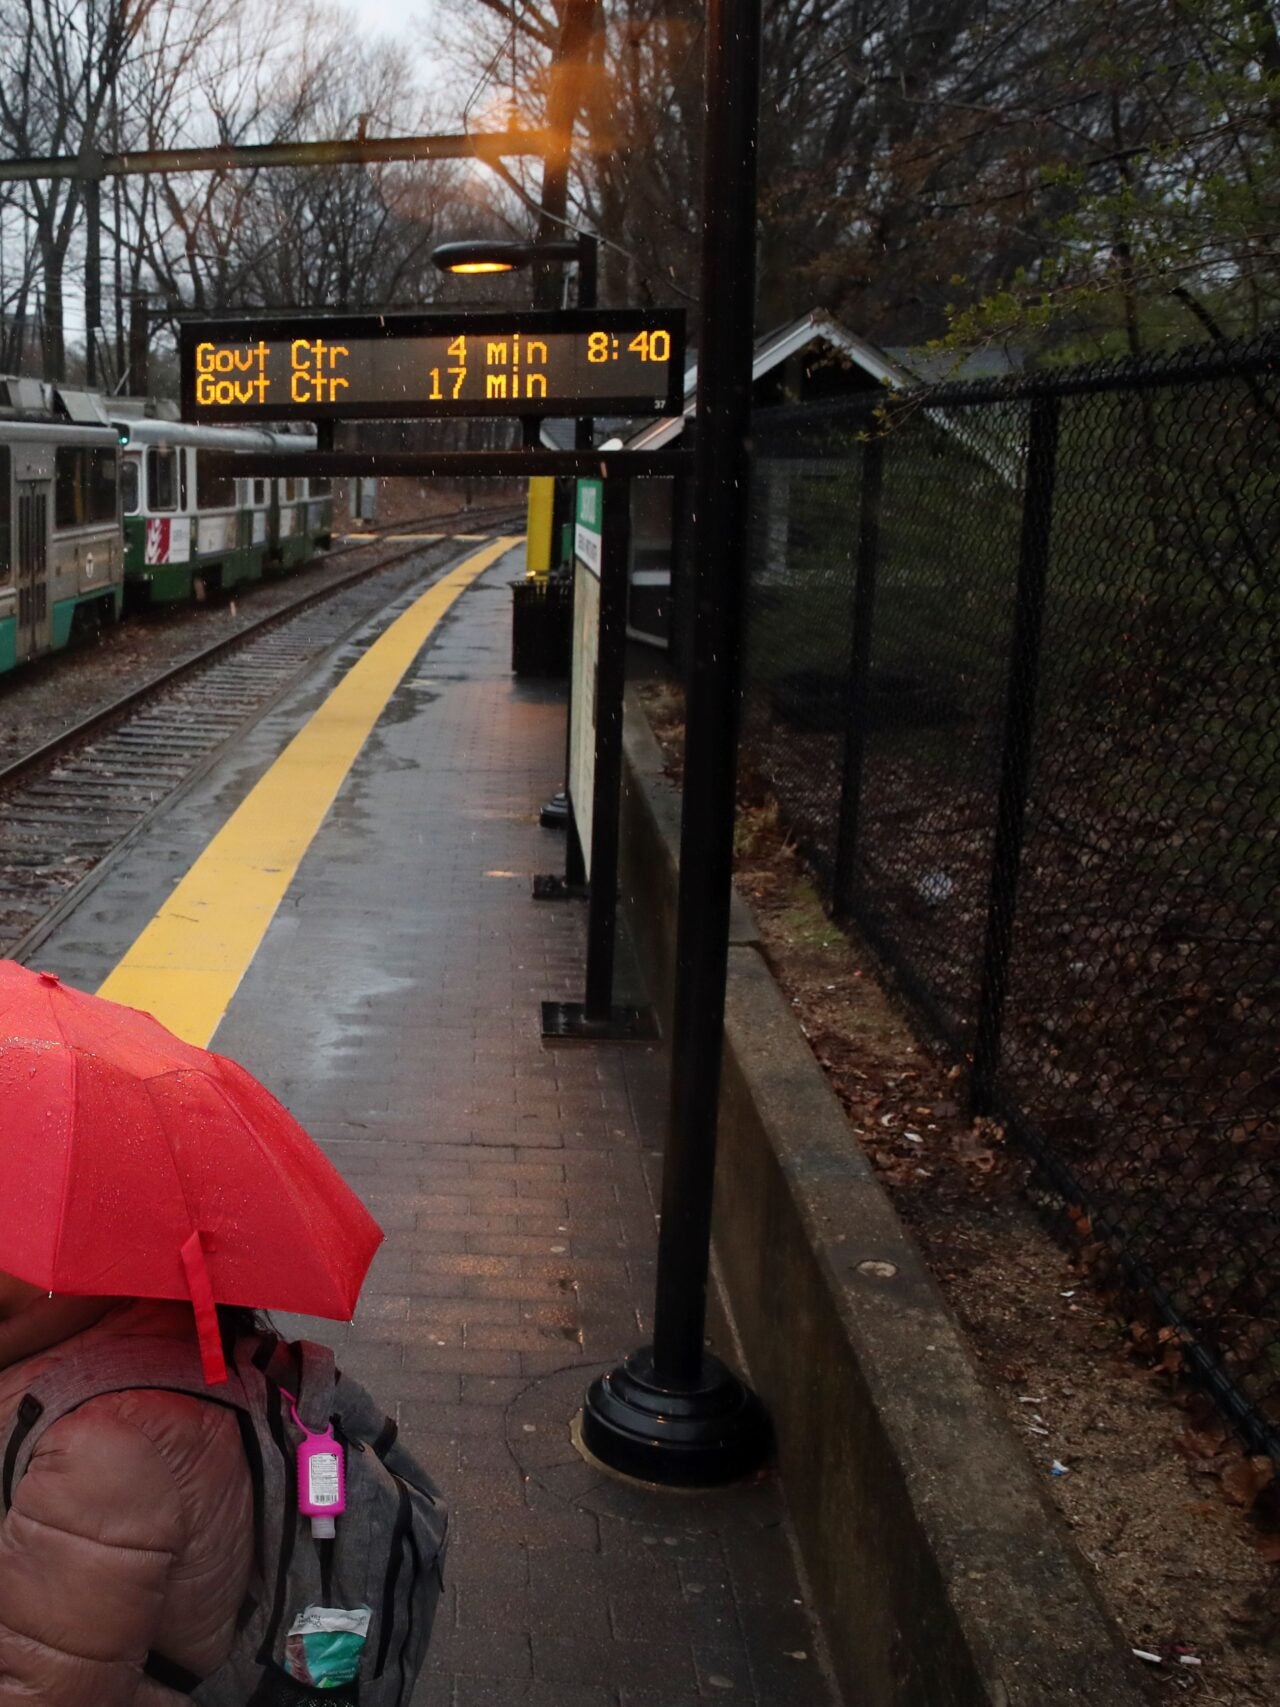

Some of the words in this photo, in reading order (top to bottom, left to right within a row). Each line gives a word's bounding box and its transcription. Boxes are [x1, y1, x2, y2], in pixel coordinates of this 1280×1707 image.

[196, 341, 270, 373] Govt
[291, 339, 349, 370] Ctr
[447, 335, 467, 365] 4
[486, 333, 548, 365] min
[587, 330, 671, 363] 8:40
[196, 373, 271, 405] Govt
[291, 371, 349, 402] Ctr
[429, 367, 467, 399] 17
[486, 366, 547, 399] min
[654, 399, 666, 409] 37
